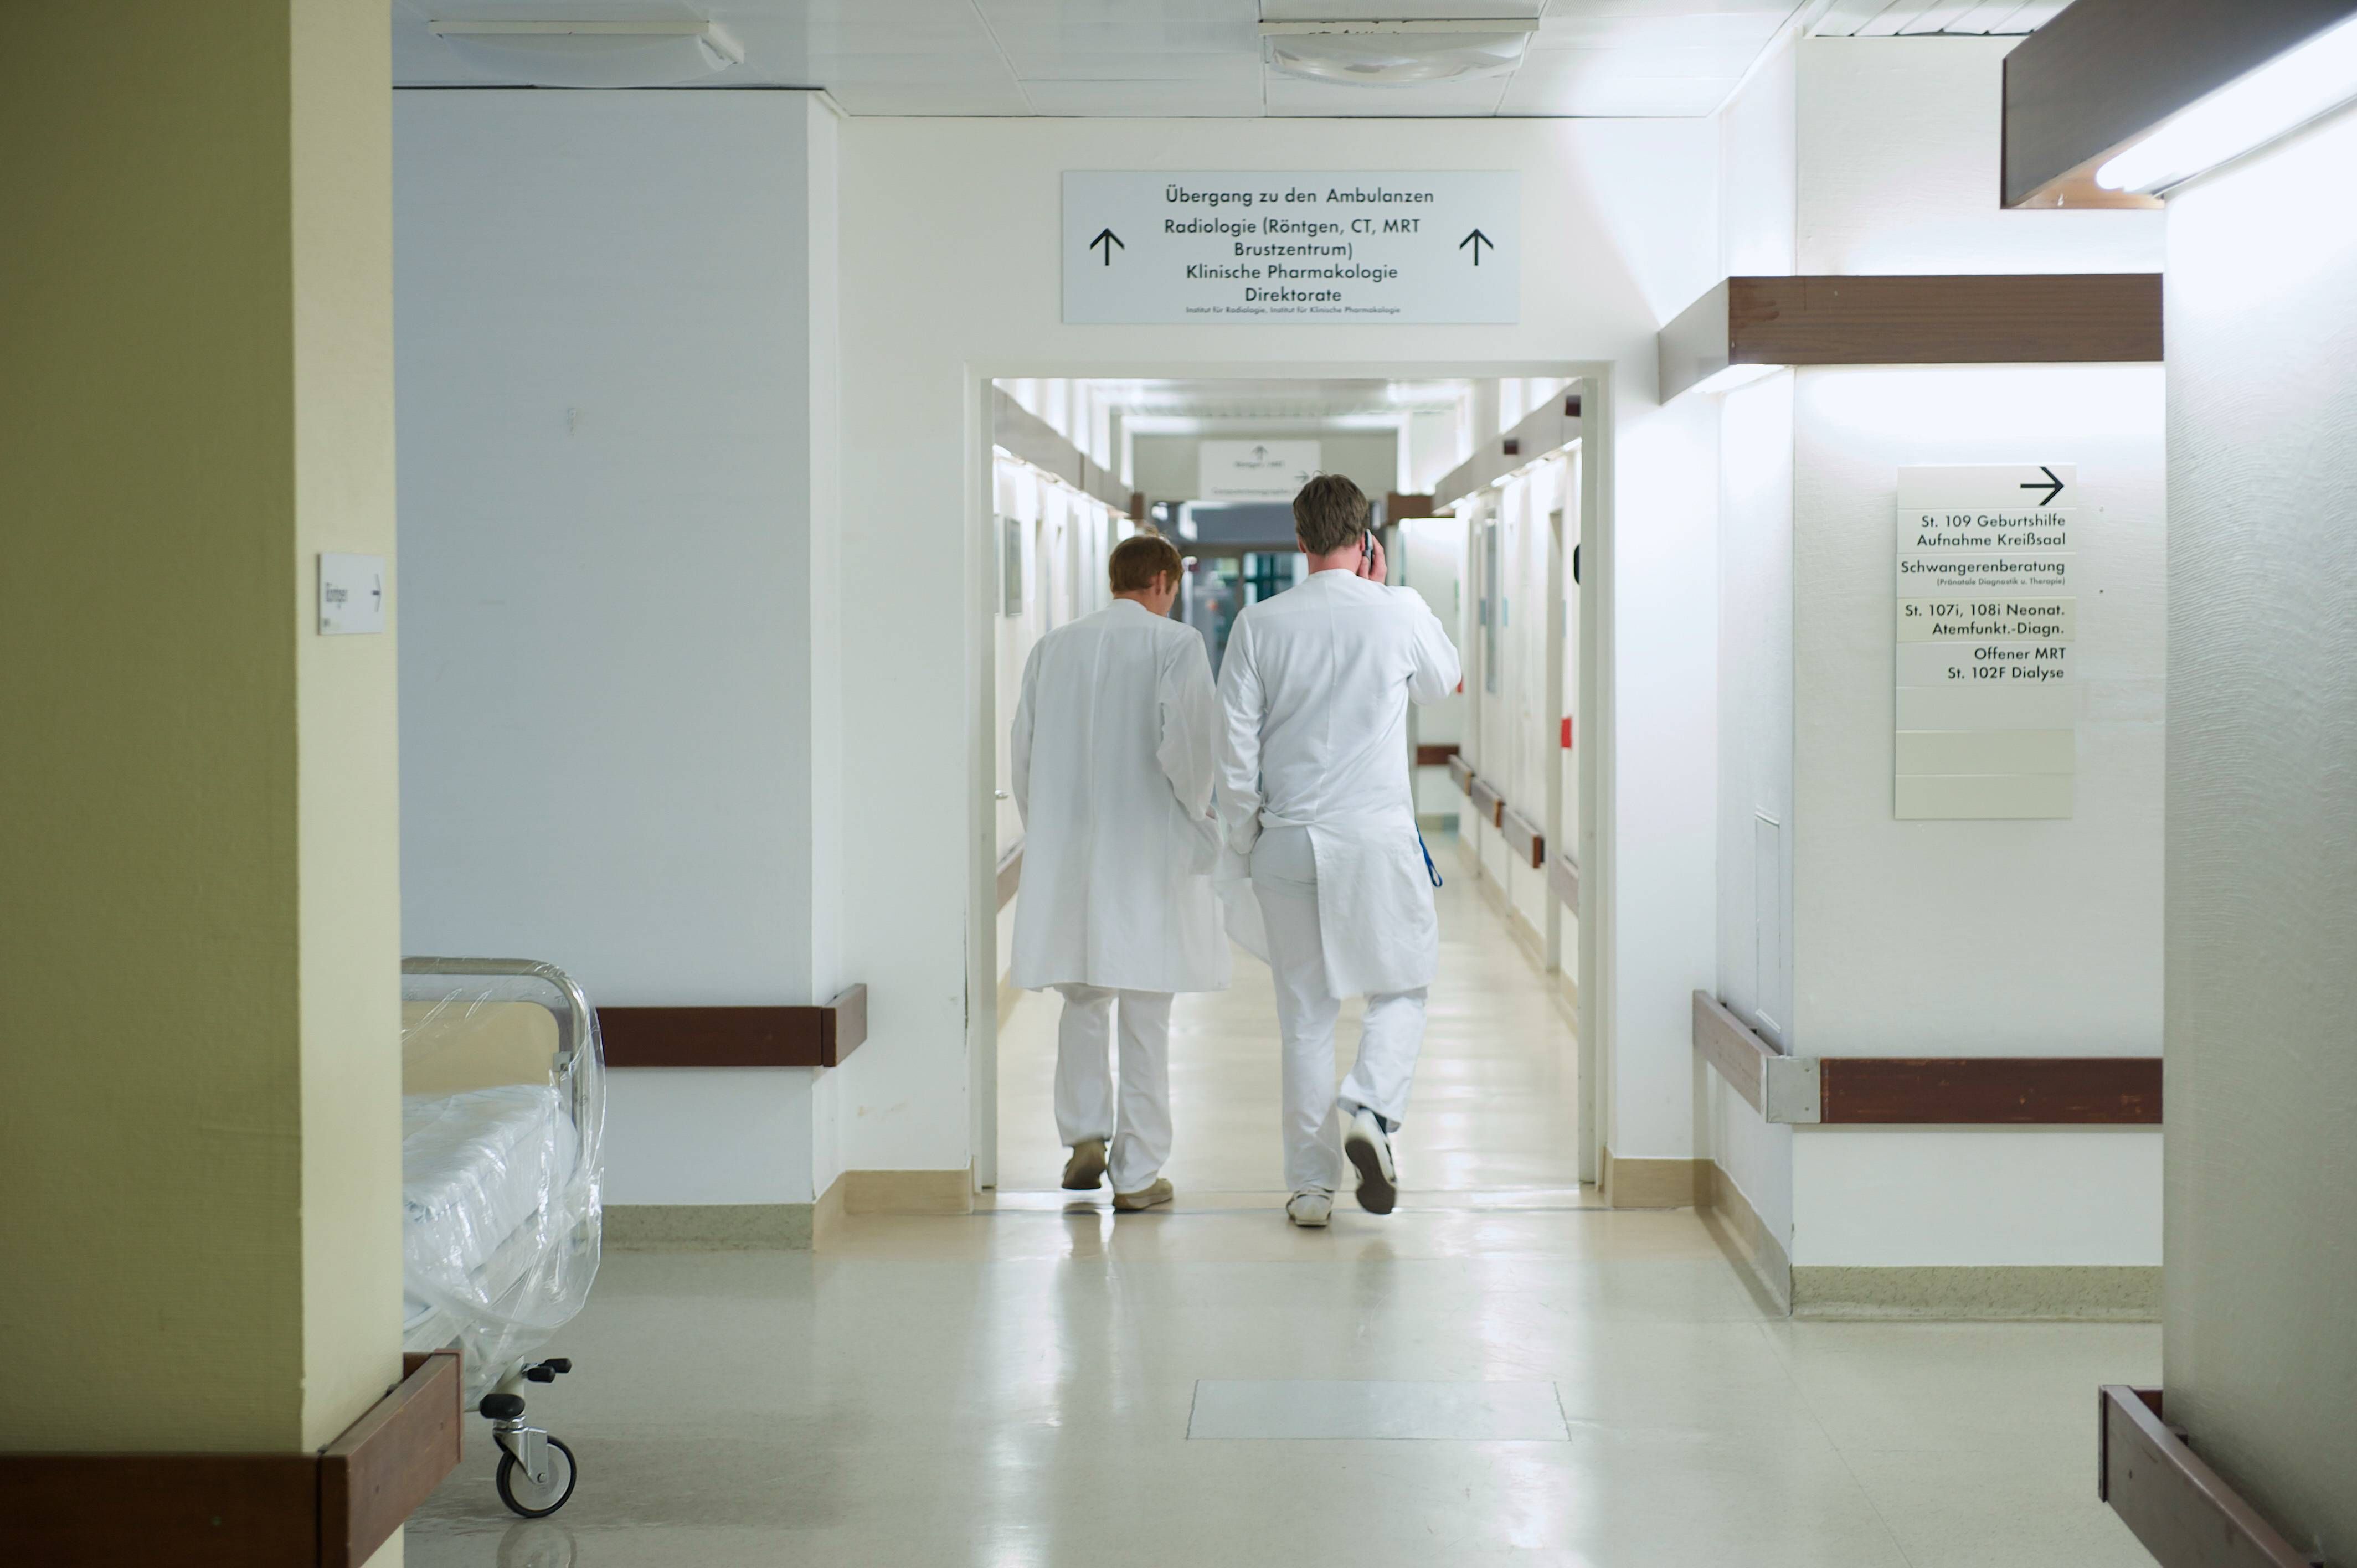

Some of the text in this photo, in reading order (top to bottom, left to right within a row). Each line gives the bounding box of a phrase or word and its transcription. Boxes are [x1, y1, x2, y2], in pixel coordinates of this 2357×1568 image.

[1166, 184, 1433, 207] Übergang zu den Ambulanzen
[1165, 216, 1421, 236] Radiologie (Röntgen, CT, MRT
[1234, 241, 1352, 261] Brustzentrum)
[1186, 263, 1398, 283] Klinische Pharmakologie
[1245, 286, 1342, 302] Direktorate
[1921, 513, 2065, 528] St. 109 Geburtshilfe
[1917, 532, 2066, 546] Aufnahme Kreißsaal
[1901, 559, 2065, 575] Schwangerenberatung
[1905, 603, 2065, 618] St. 107i, 108i Neonat.
[1932, 621, 2064, 637] Atemfunkt.-Diagn.
[1974, 646, 2066, 661] Offener MRT
[1948, 664, 2064, 682] St. 102F Dialyse
